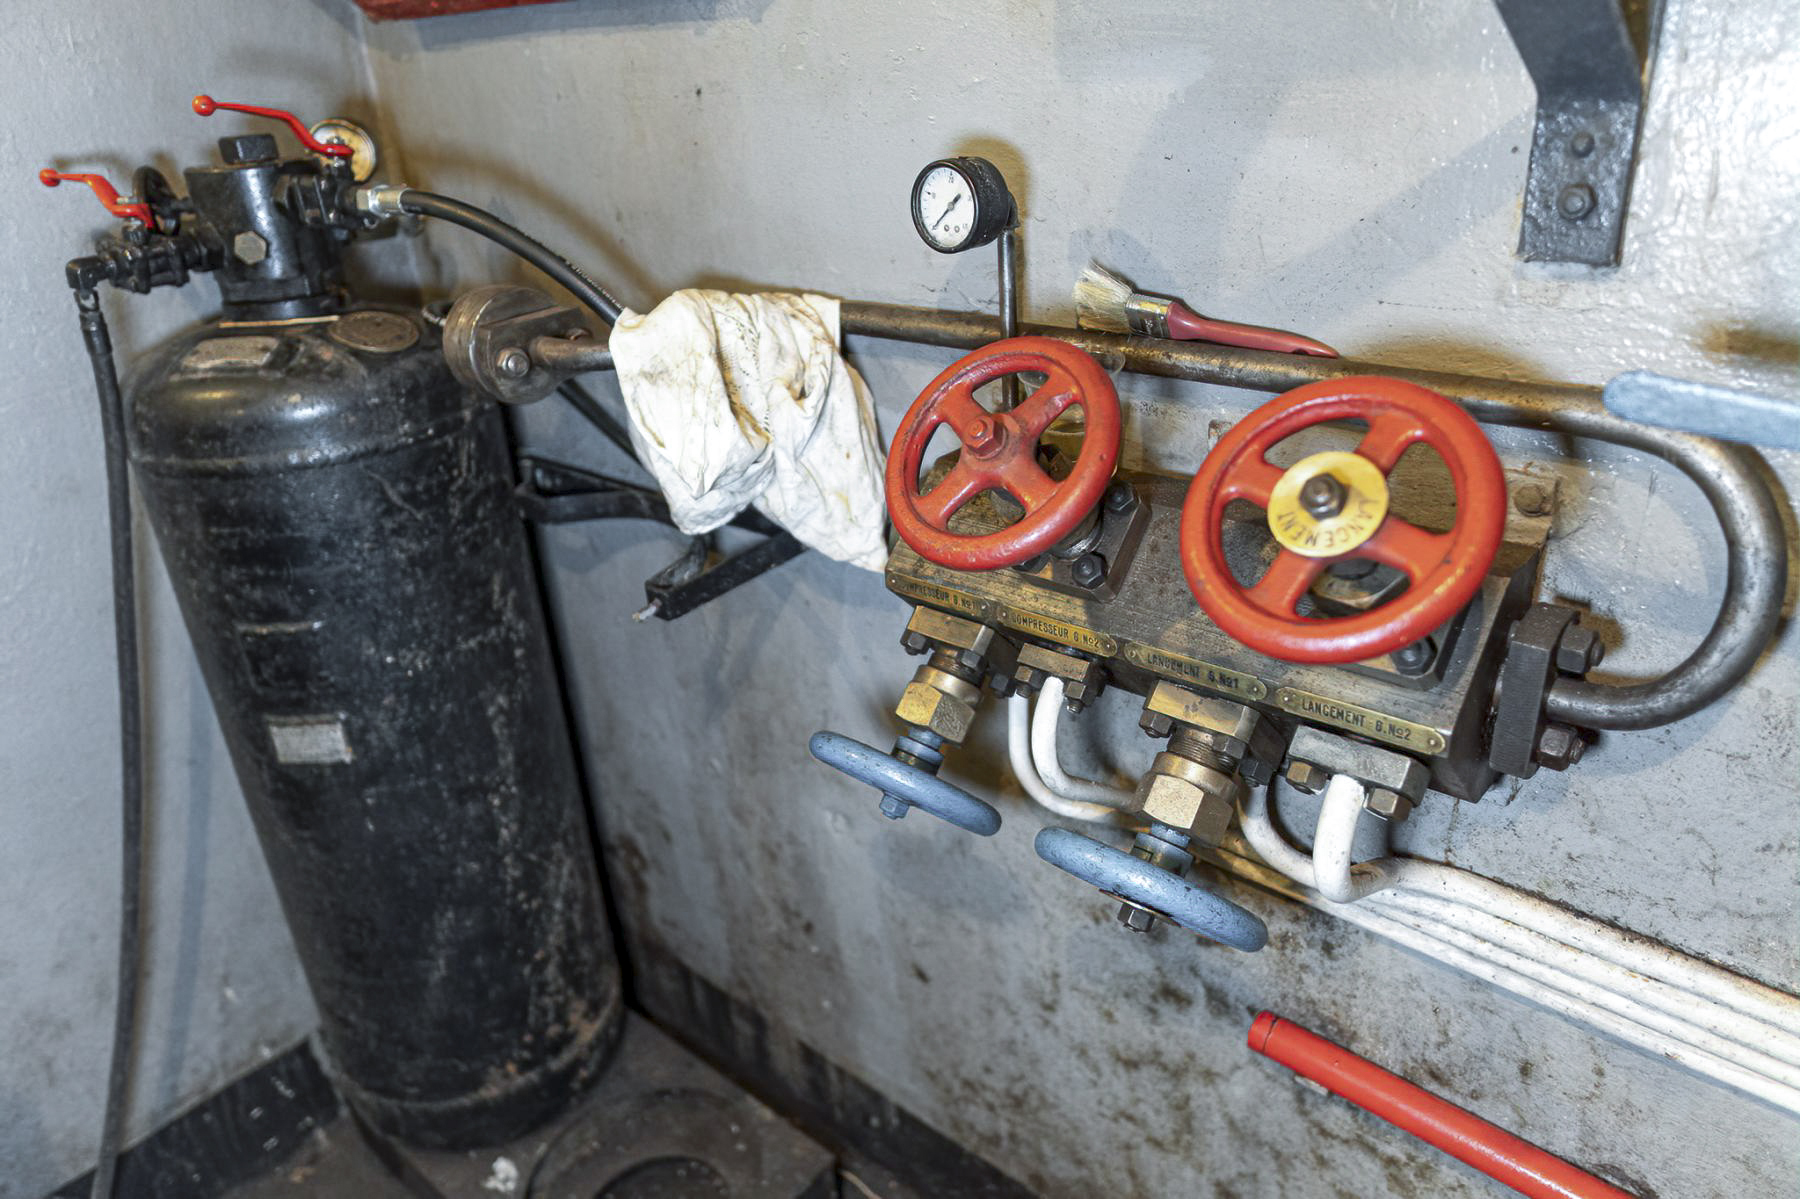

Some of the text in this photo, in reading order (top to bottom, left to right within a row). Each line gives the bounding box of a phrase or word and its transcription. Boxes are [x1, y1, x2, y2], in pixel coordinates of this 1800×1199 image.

[1277, 498, 1379, 548] LANCEMENT
[1013, 614, 1069, 638] COMPRESSEUR
[1301, 699, 1366, 727] LANCEMENT
